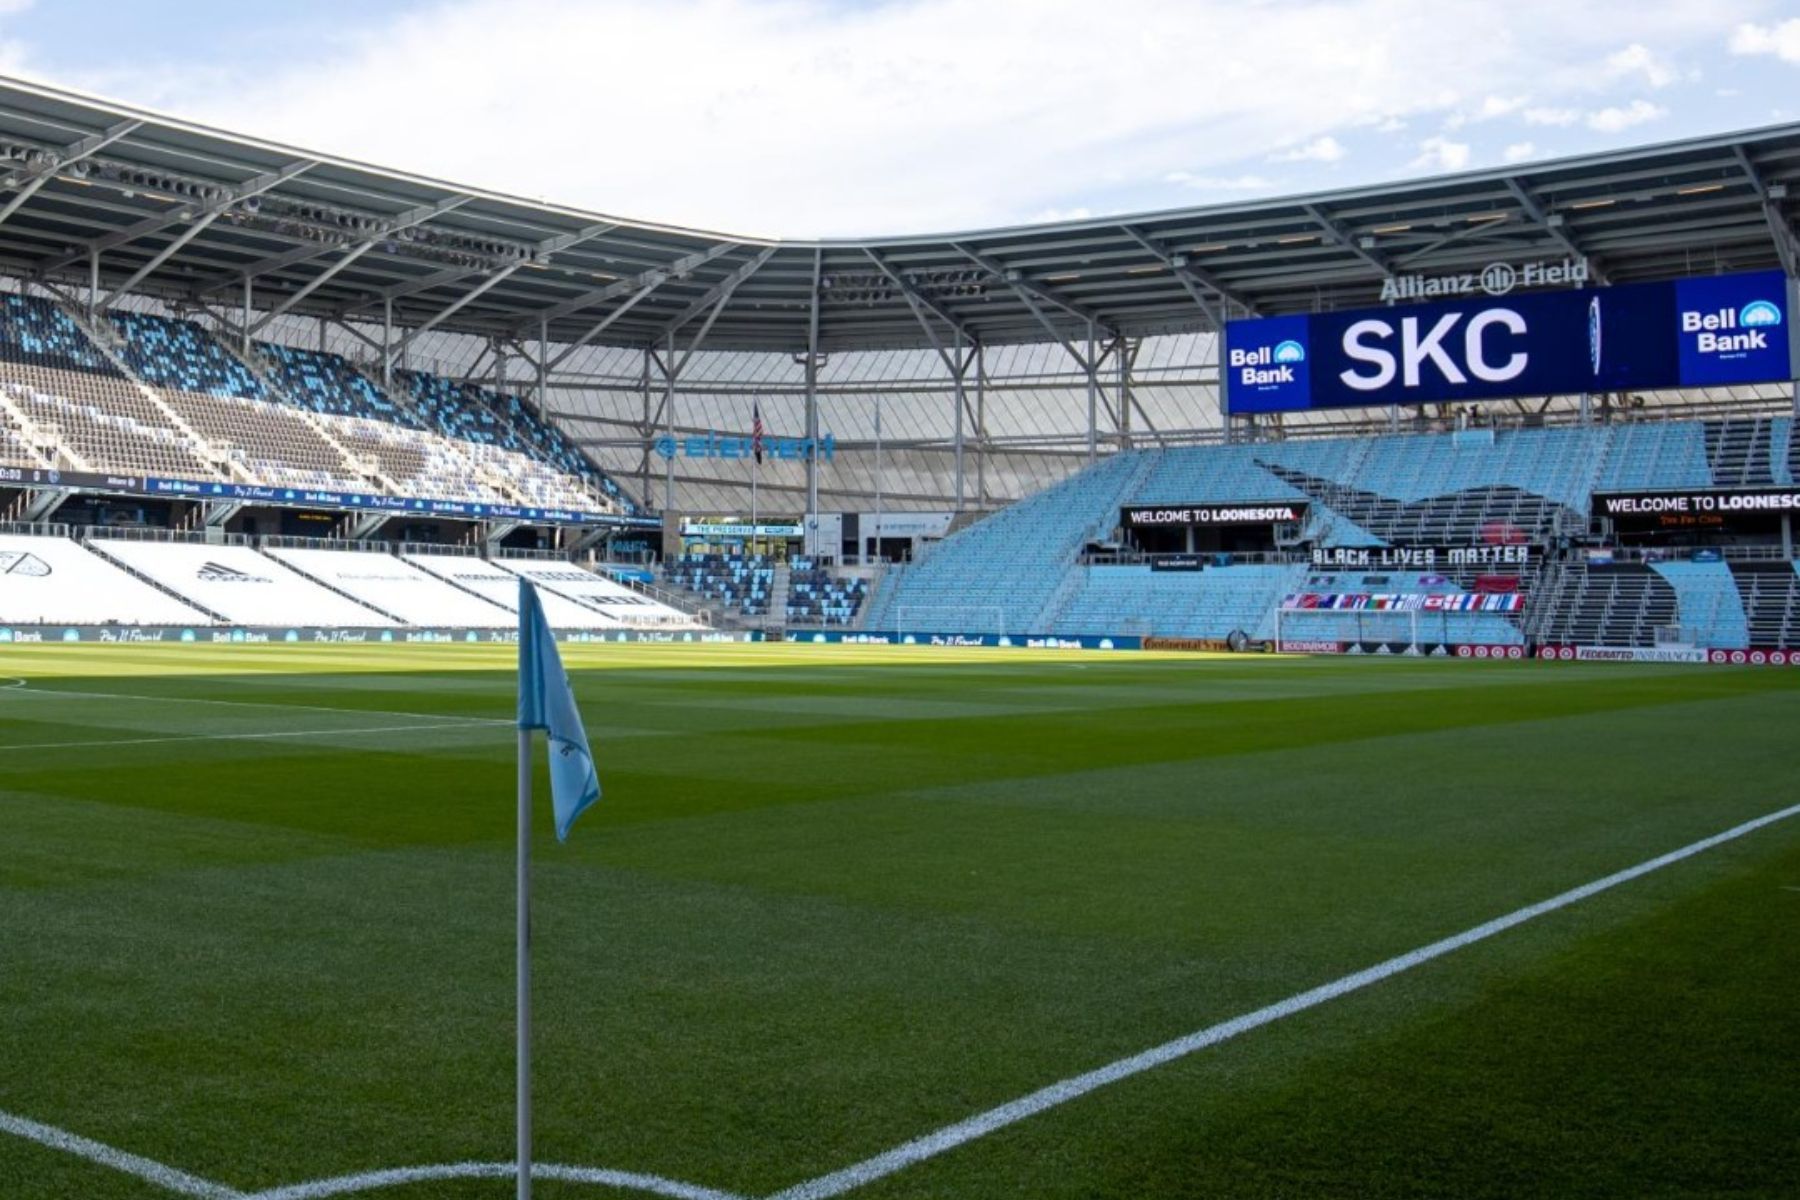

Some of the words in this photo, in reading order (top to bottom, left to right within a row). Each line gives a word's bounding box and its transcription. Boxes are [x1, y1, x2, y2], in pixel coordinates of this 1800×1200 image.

[1380, 274, 1474, 301] Allianz
[1522, 256, 1589, 286] Field
[1682, 307, 1736, 332] Bell
[1339, 308, 1528, 391] SKC
[1697, 329, 1768, 353] Bank
[1230, 346, 1271, 367] Bell
[1242, 364, 1295, 385] Bank
[1605, 497, 1689, 513] WELCOME
[1692, 496, 1715, 511] TO
[1131, 510, 1191, 524] WELCOME
[1193, 510, 1210, 522] TO
[1312, 549, 1370, 566] BLACK
[1382, 549, 1435, 566] LIVES
[1447, 546, 1529, 564] MATTER
[1579, 649, 1634, 659] FEDERATED
